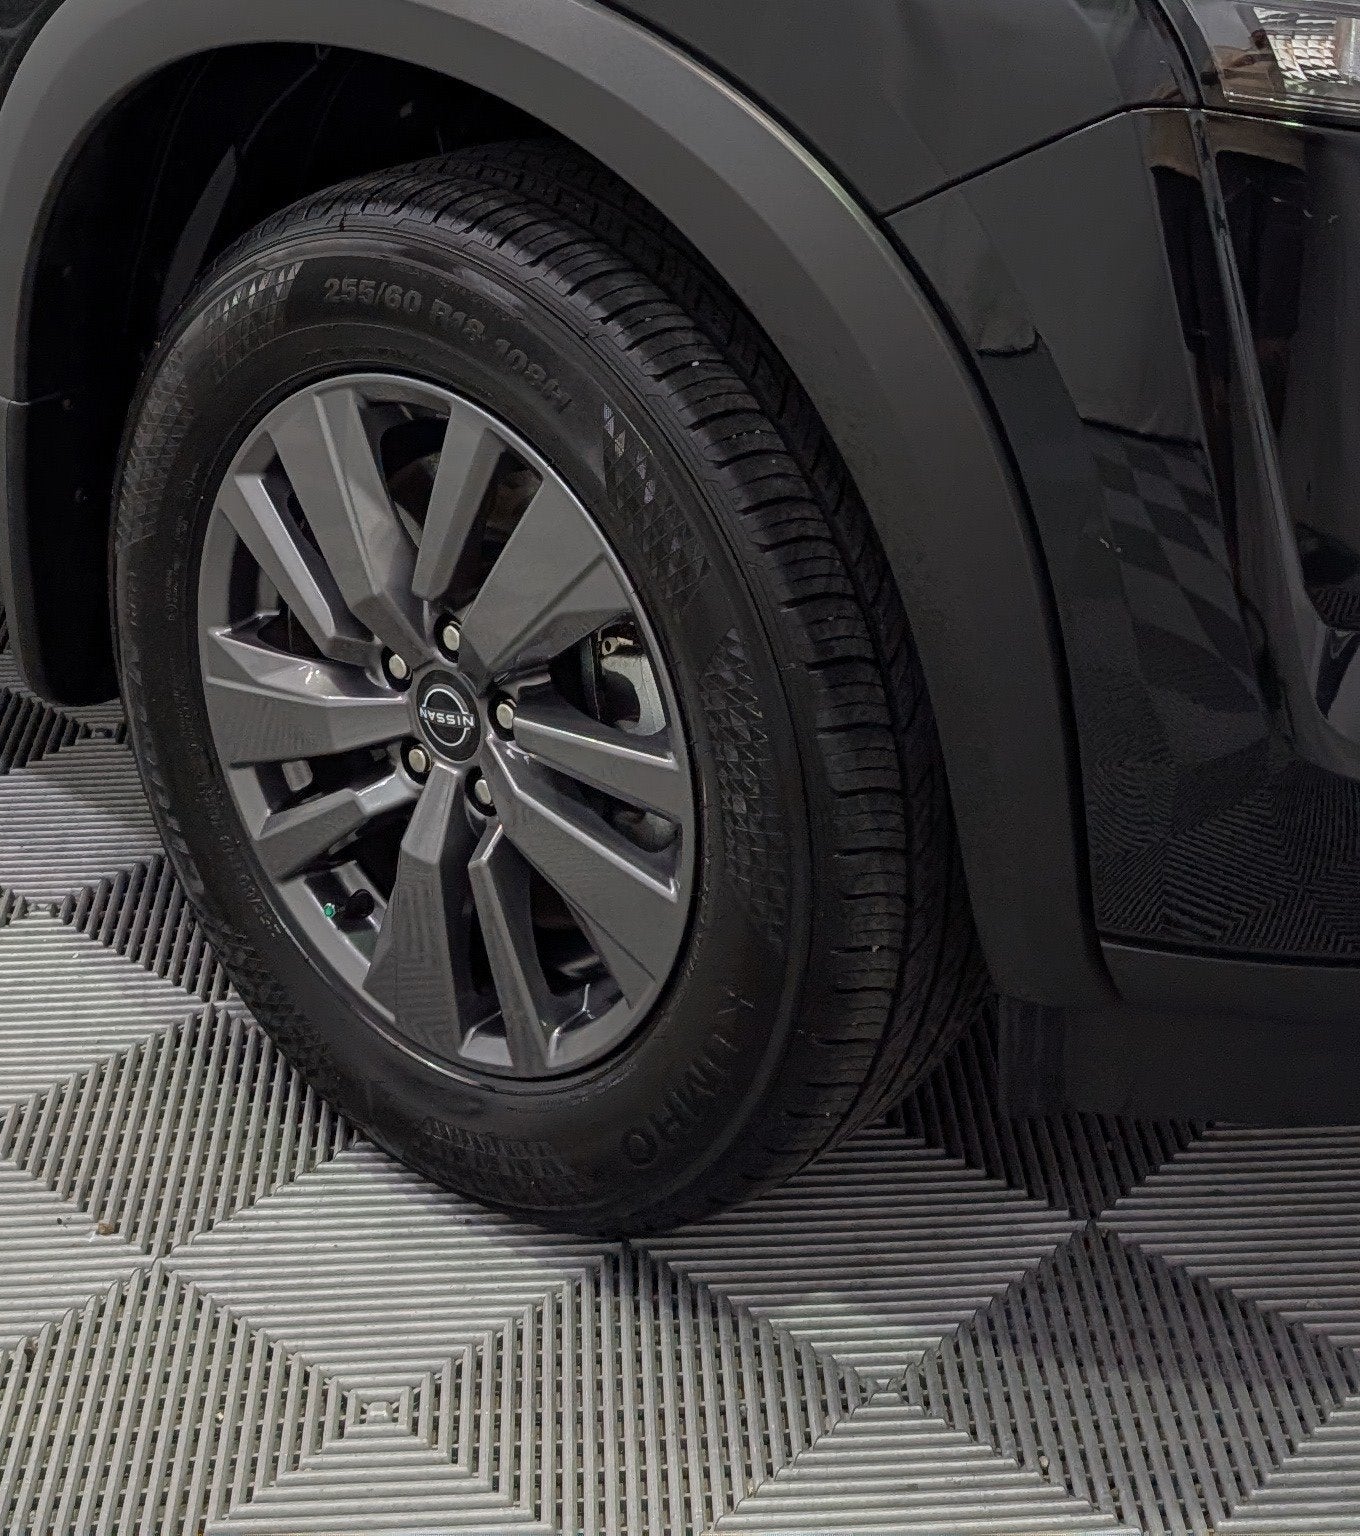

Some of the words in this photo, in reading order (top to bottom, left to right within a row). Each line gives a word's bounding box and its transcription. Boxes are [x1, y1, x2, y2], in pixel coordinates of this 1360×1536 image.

[323, 277, 423, 314] 255/60
[429, 297, 487, 344] R18
[419, 706, 476, 727] NISSAN
